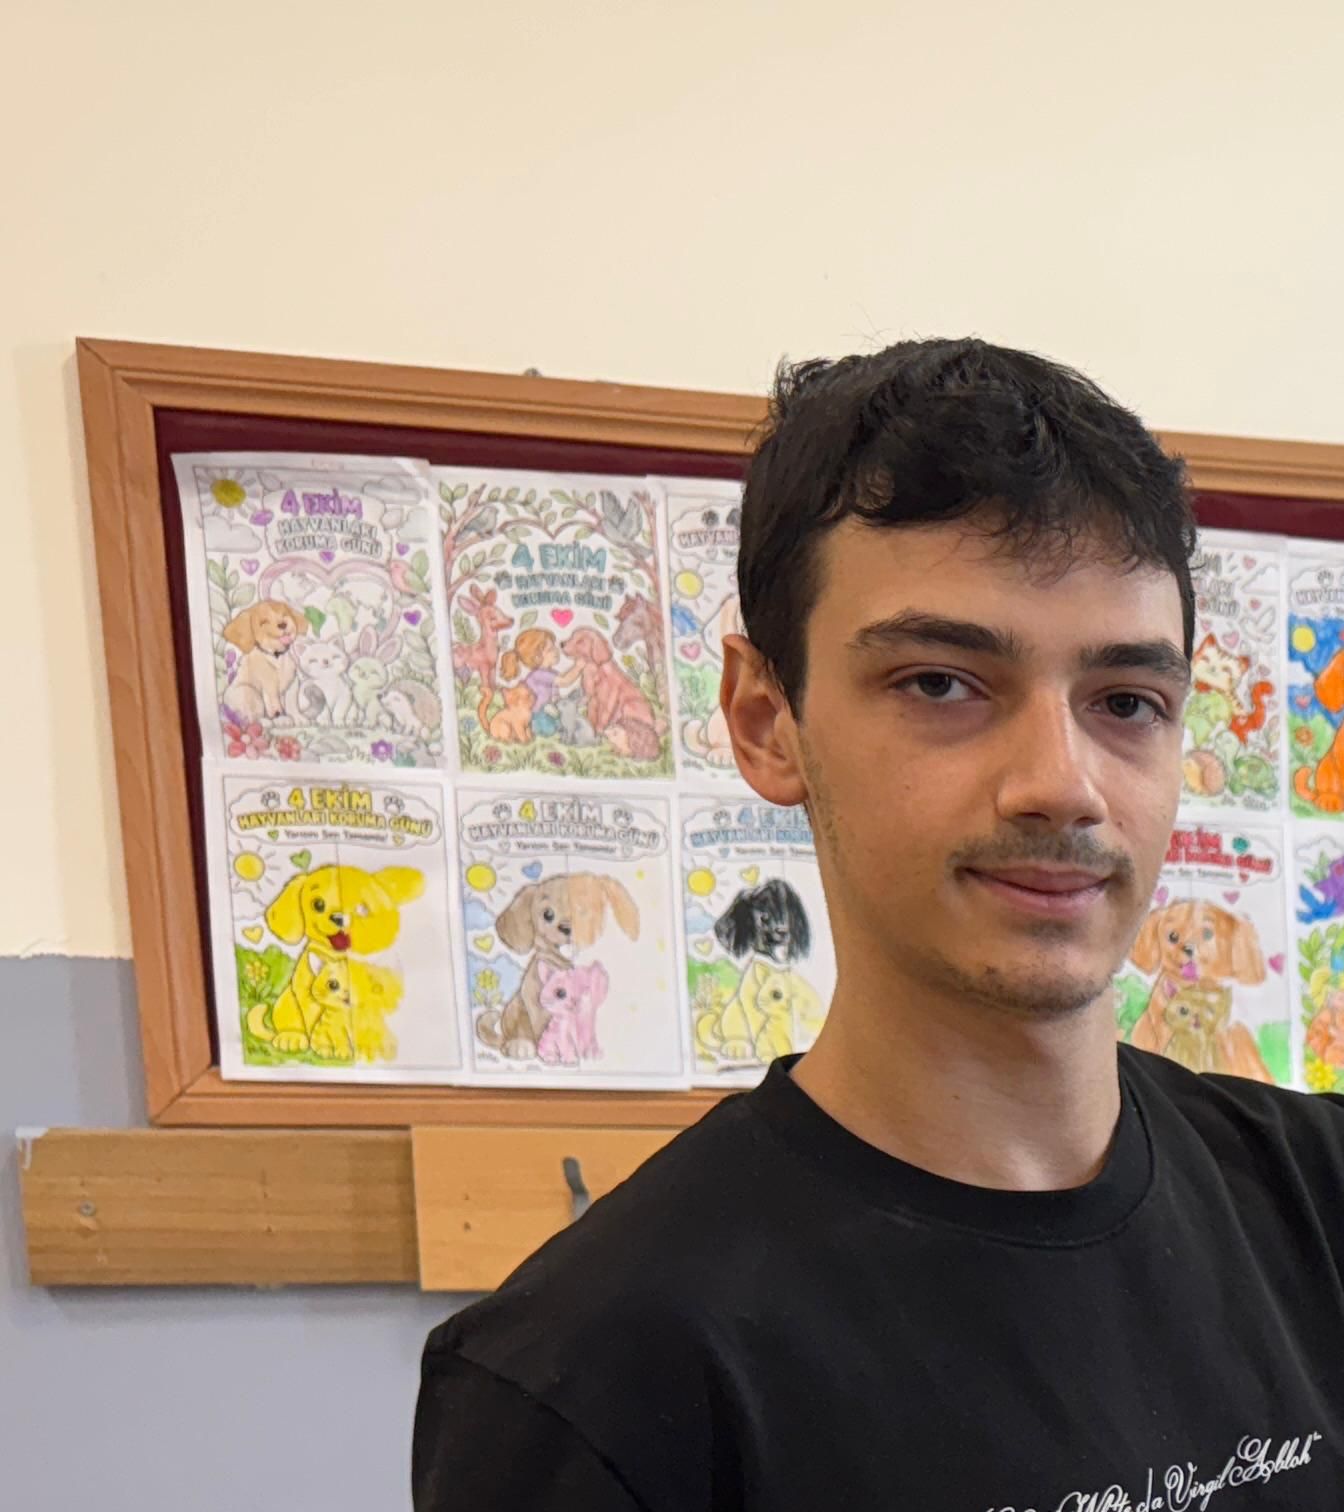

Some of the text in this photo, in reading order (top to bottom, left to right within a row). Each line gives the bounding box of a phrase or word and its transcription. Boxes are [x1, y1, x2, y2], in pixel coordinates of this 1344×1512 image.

[280, 487, 363, 520] 4 EKİM
[511, 540, 607, 573] 4 EKİM
[288, 784, 372, 813] 4 EKİM
[518, 795, 603, 824] 4 EKİM
[237, 810, 433, 838] HAYVANLARI KORUMA GÜNÜ
[468, 822, 557, 842] HAYVANLARI
[616, 828, 660, 849] GÜNÜ
